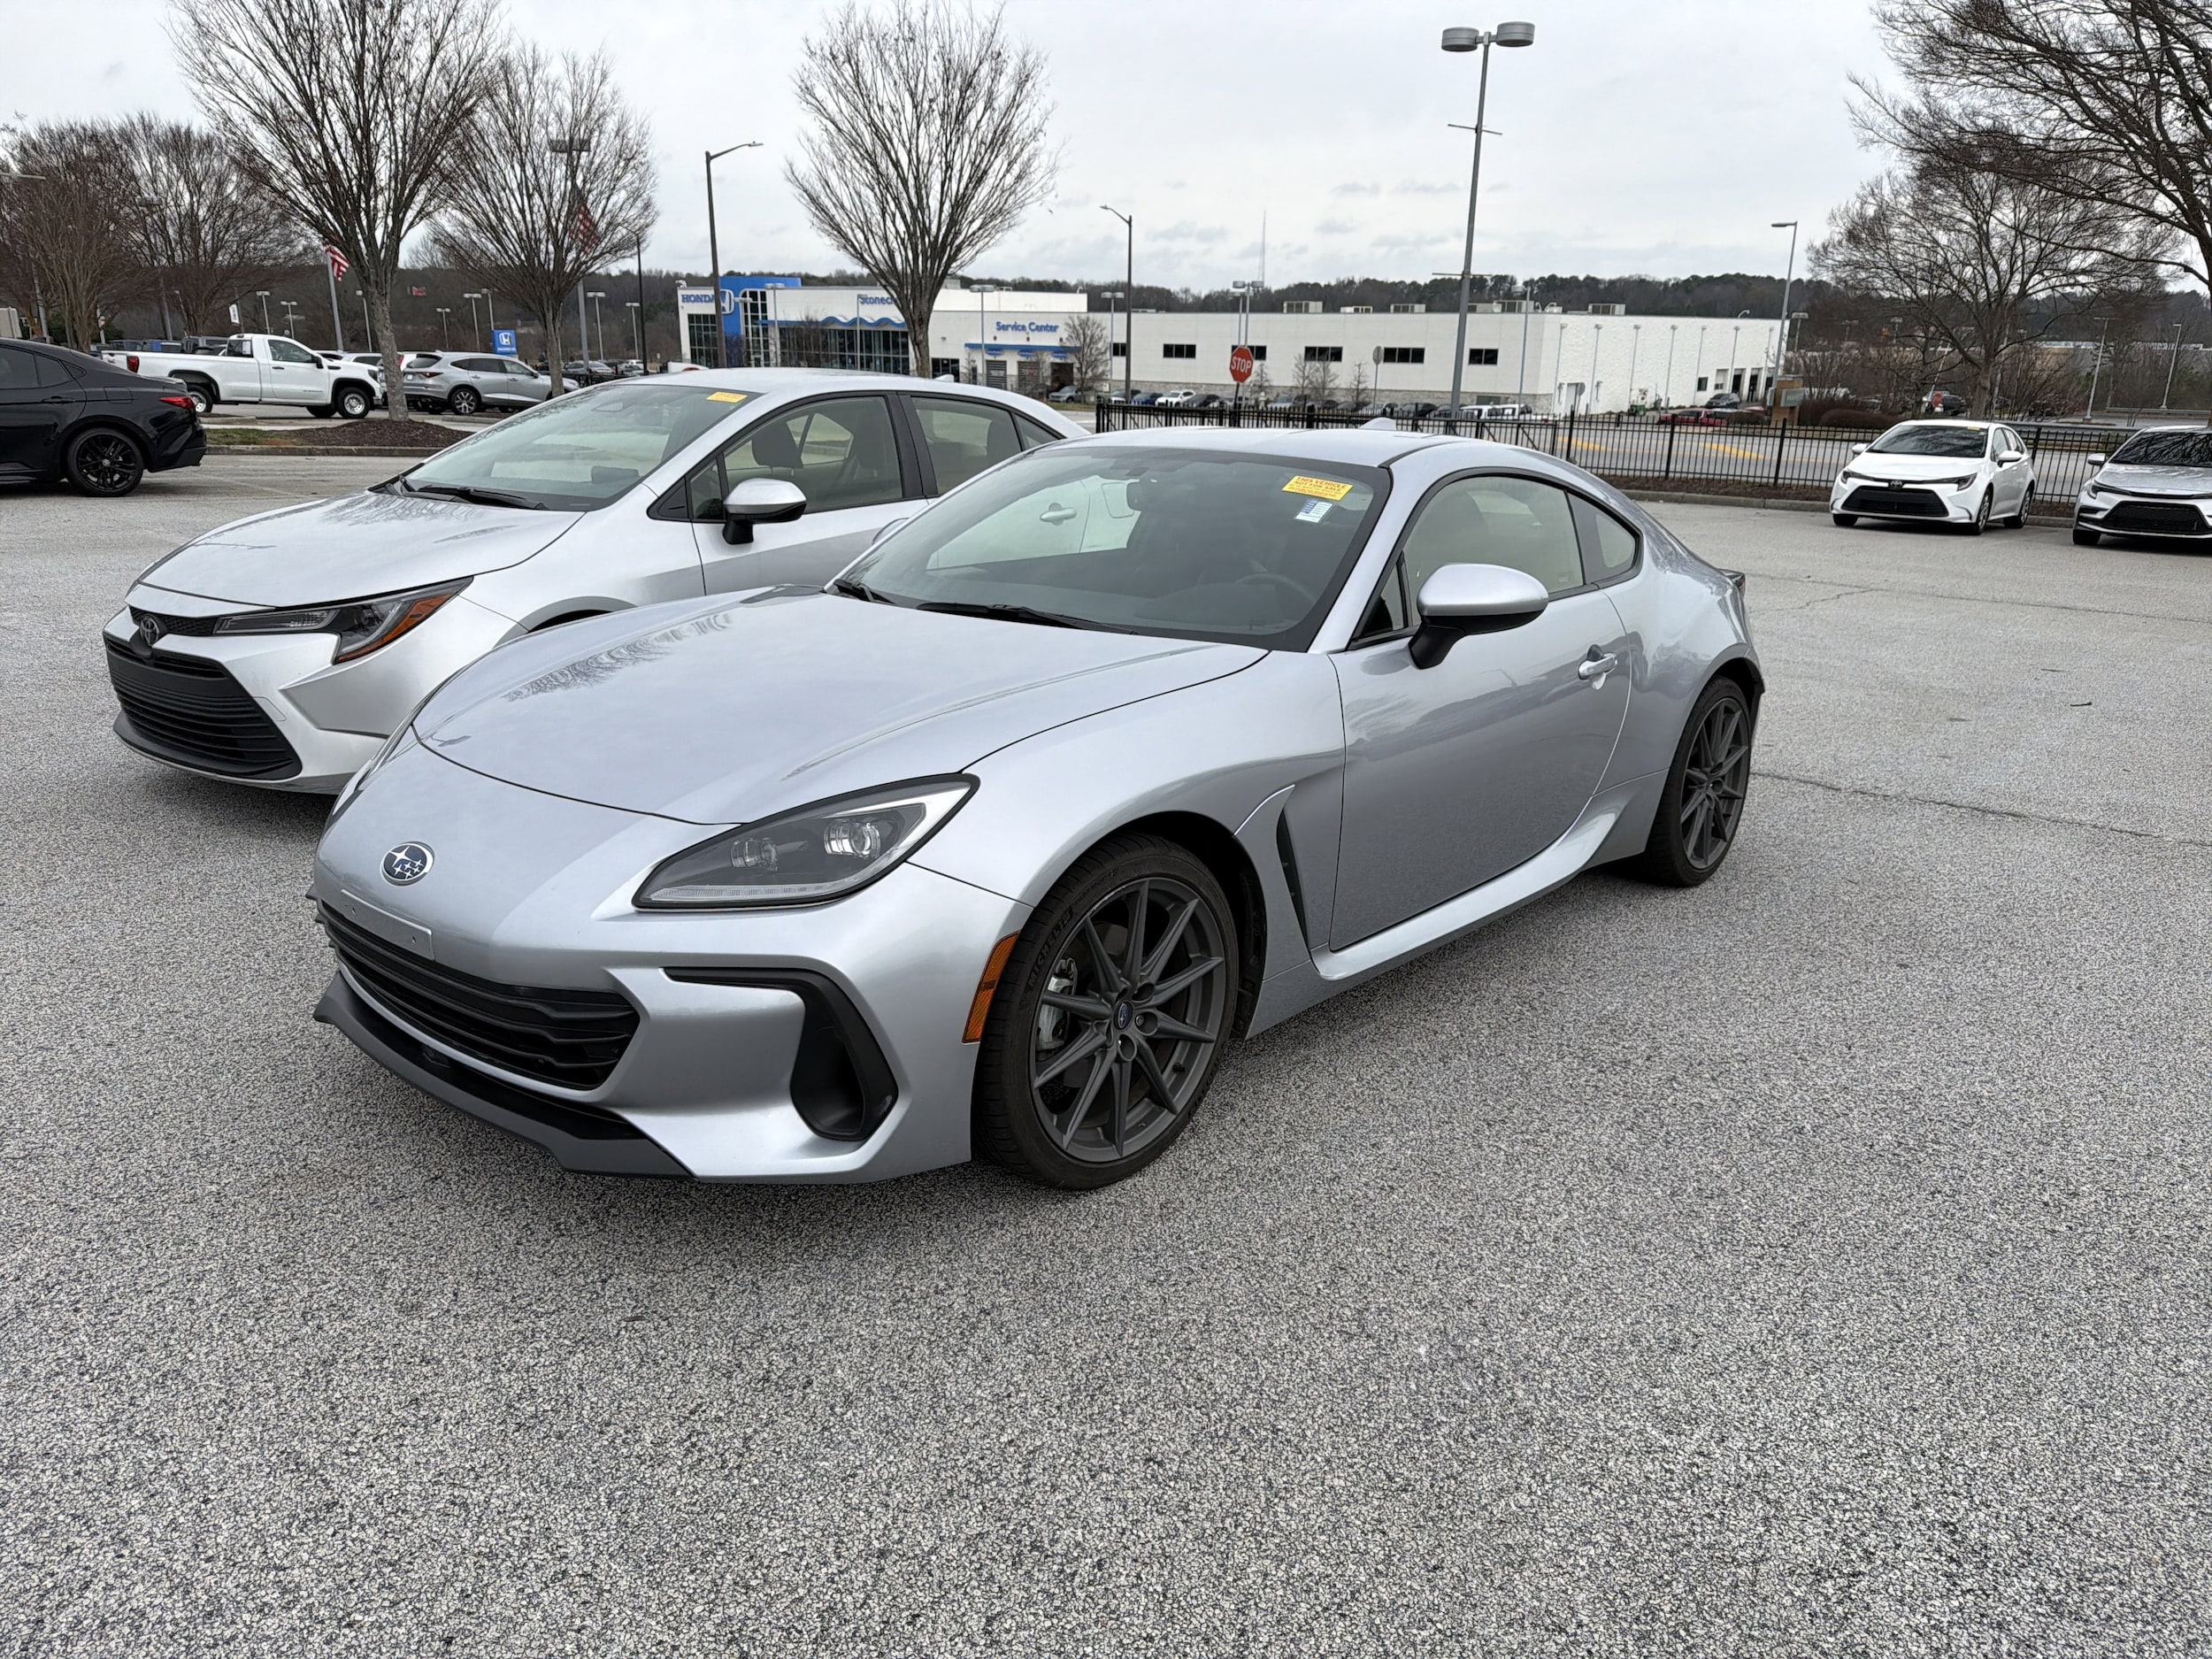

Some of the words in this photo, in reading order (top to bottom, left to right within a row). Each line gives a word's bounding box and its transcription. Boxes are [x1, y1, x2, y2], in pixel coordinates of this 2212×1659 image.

[859, 296, 894, 304] Stonec
[995, 321, 1026, 332] Service
[1028, 321, 1059, 333] Center
[1231, 356, 1252, 373] STOP
[1315, 480, 1347, 488] VEHICLE
[1026, 908, 1072, 989] MICHELIN
